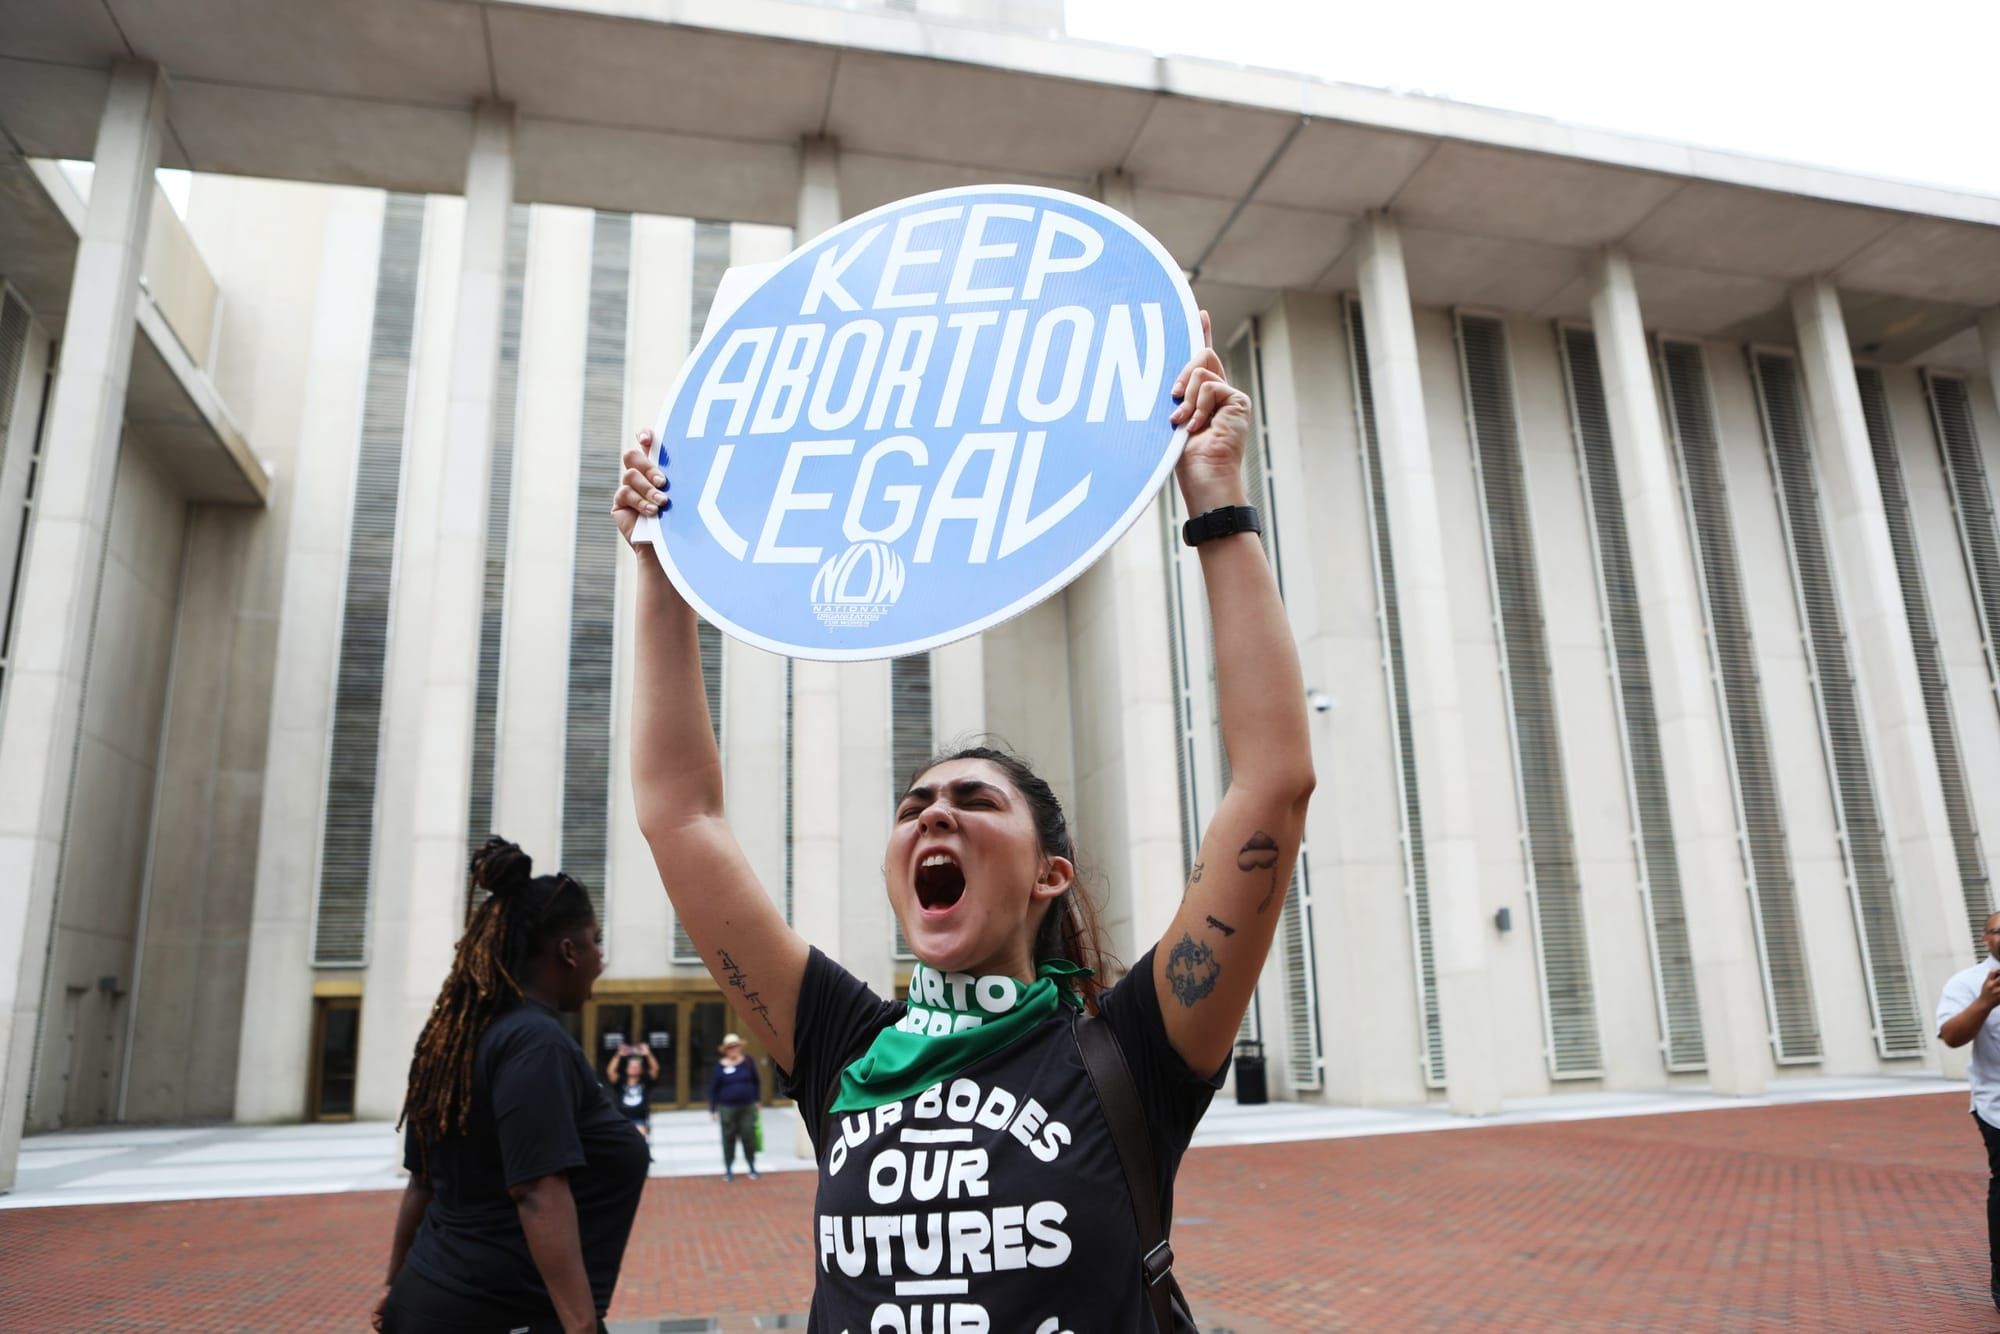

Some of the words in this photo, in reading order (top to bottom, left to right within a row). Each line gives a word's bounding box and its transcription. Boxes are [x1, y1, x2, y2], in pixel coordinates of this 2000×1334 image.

[799, 203, 1105, 316] KEEP
[686, 302, 1166, 439] ABORTION
[697, 431, 1092, 564] LEGAL
[810, 542, 907, 604] NOW
[812, 605, 888, 613] NATIONAL
[829, 1101, 904, 1177] OUR
[868, 1148, 989, 1205] OUR
[819, 1200, 1073, 1278] FUTURES
